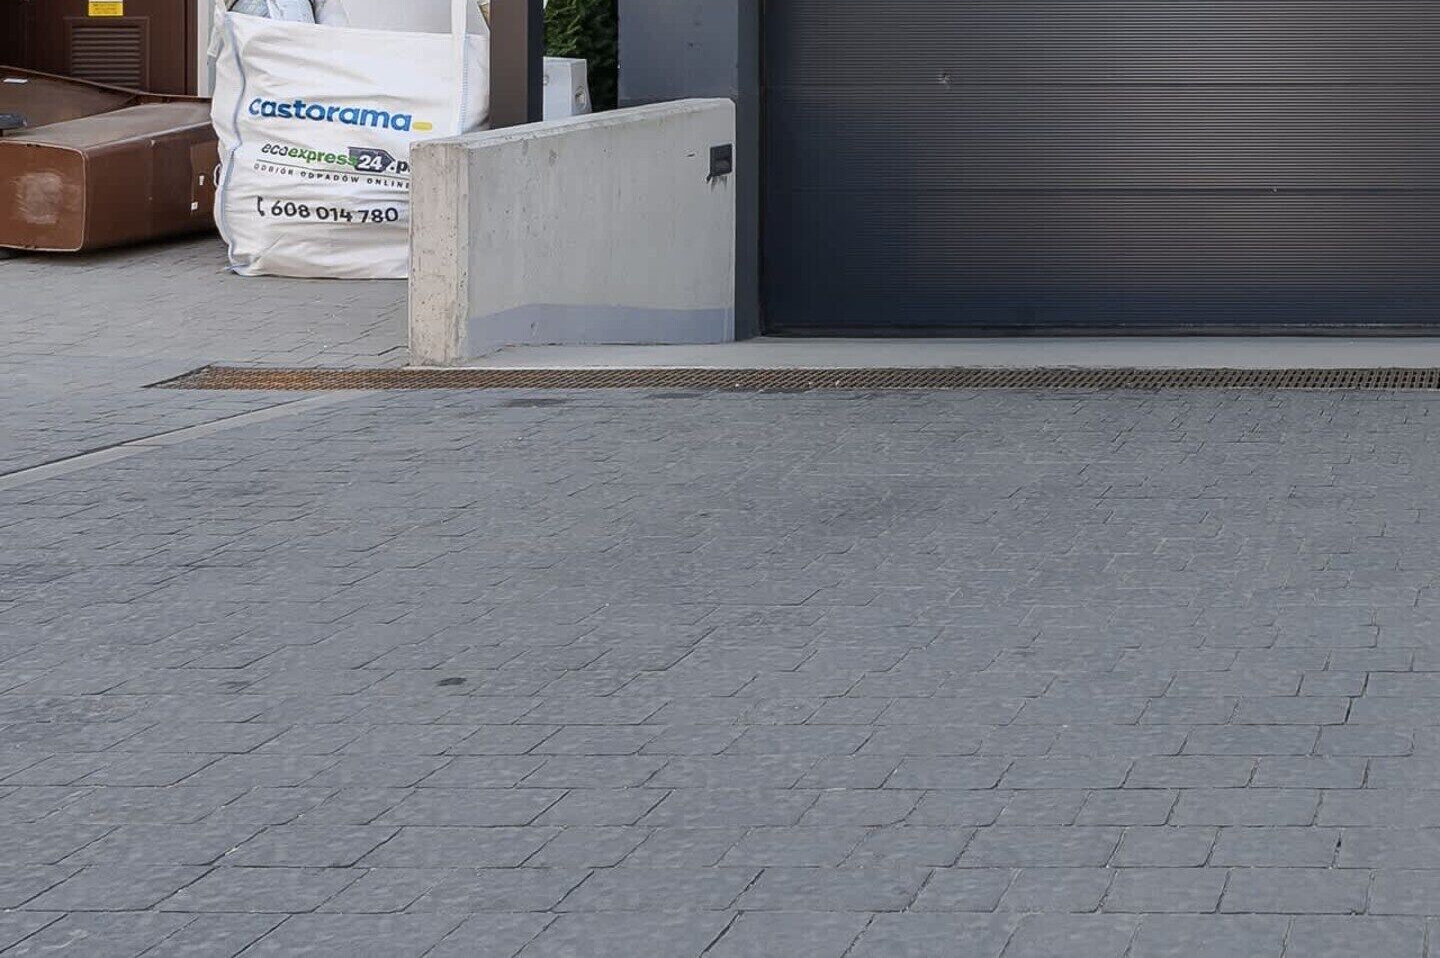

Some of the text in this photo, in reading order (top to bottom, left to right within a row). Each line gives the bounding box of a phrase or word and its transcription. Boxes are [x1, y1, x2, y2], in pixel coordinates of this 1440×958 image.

[248, 97, 412, 133] castorama
[261, 142, 411, 175] ecoexpress24.p
[300, 171, 360, 184] ODPADÓW
[271, 200, 399, 223] 608 014 780
